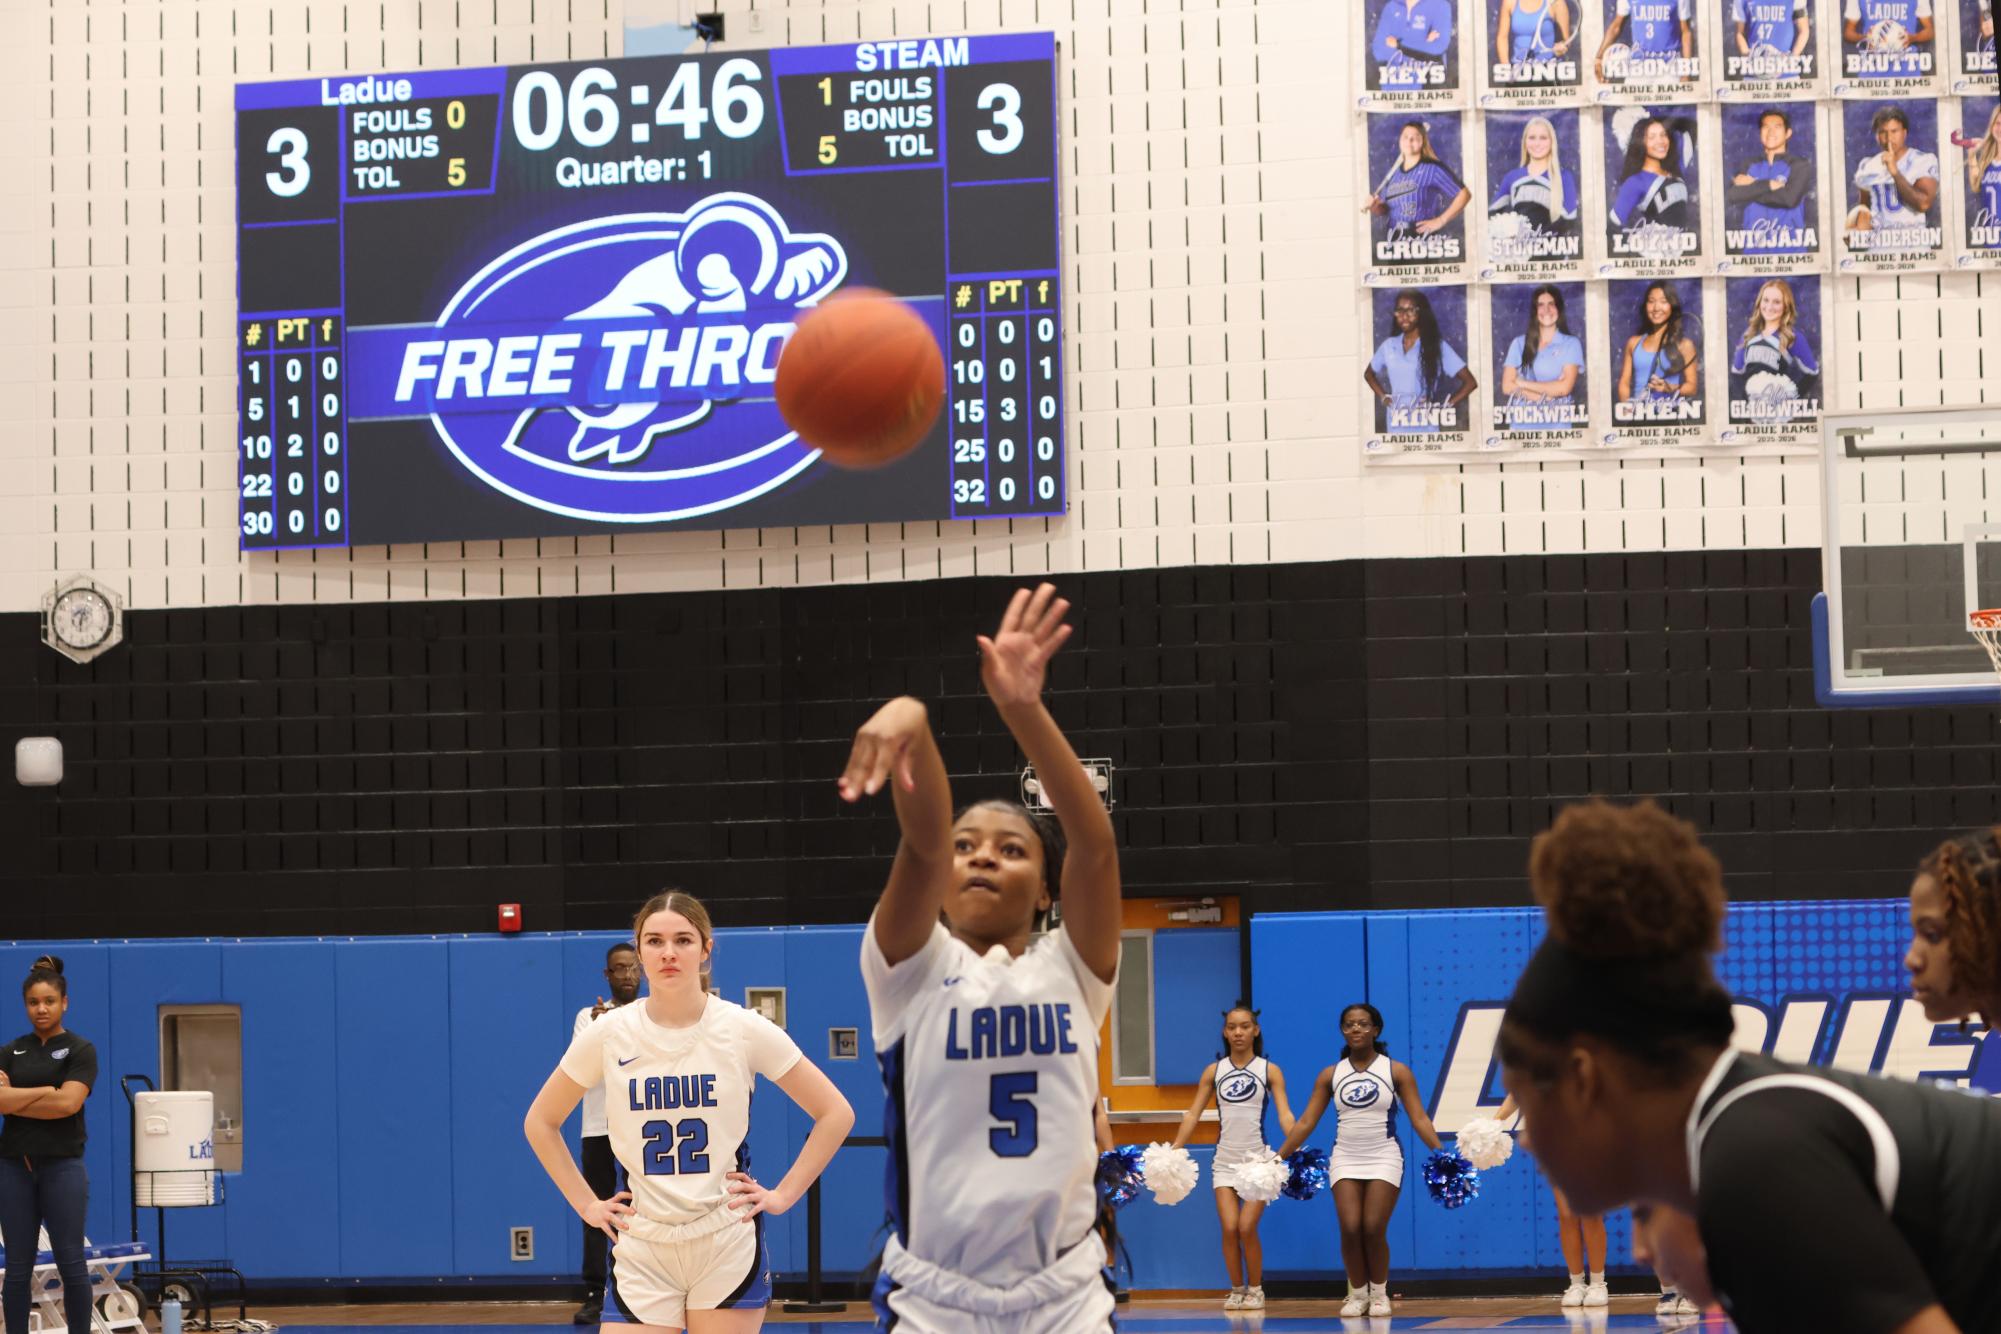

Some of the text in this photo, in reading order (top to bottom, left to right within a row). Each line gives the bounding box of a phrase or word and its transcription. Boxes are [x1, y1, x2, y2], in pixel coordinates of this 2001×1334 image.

[1634, 5, 1671, 21] LADUE
[1867, 4, 1907, 20] LADUE
[1646, 24, 1654, 39] 3
[1757, 24, 1773, 39] 47
[854, 36, 970, 72] STEAM
[1728, 54, 1814, 75] PROSKEY
[1378, 64, 1445, 84] KEYS
[1731, 81, 1812, 91] LADUE RAMS
[1850, 78, 1930, 88] LADUE RAMS
[319, 74, 413, 106] Ladue
[818, 76, 932, 106] 1 FOULS
[1373, 90, 1453, 101] LADUE RAMS
[1496, 88, 1576, 98] LADUE RAMS
[1613, 83, 1694, 94] LADUE RAMS
[353, 100, 466, 134] FOULS 0
[512, 57, 765, 151] 06:46
[843, 104, 933, 132] BONUS
[976, 82, 1024, 155] 3
[265, 127, 311, 197] 3
[353, 134, 440, 162] BONUS
[818, 133, 934, 164] 5 TOL
[353, 157, 466, 189] TOL 5
[555, 150, 712, 188] Quarter: 1
[1377, 239, 1460, 259] CROSS
[1850, 227, 1942, 248] HENDERSON
[1970, 226, 2001, 246] DU
[1380, 265, 1460, 276] LADUE RAMS
[1497, 262, 1578, 272] LADUE RAMS
[1615, 258, 1696, 268] LADUE RAMS
[1732, 255, 1814, 265] LADUE RAMS
[1856, 253, 1936, 262] LADUE RAMS
[955, 279, 1049, 308] # PT f
[245, 318, 332, 346] # PT f
[958, 317, 1054, 348] 0 0 0
[248, 356, 338, 384] 1 0 0
[394, 321, 798, 402] FREE THRO
[953, 356, 1052, 384] 10 0 1
[248, 393, 339, 421] 5 1 0
[954, 395, 1056, 423] 15 3 0
[1392, 408, 1456, 427] KING
[1494, 404, 1589, 424] STOCKWELL
[1615, 400, 1702, 421] CHEN
[1383, 433, 1464, 443] LADUE RAMS
[1501, 430, 1582, 440] LADUE RAMS
[1619, 427, 1700, 437] LADUE RAMS
[1736, 424, 1818, 434] LADUE RAMS
[242, 431, 339, 459] 10 2 0
[954, 436, 1054, 463] 25 0 0
[242, 470, 340, 498] 22 0 0
[953, 475, 1055, 503] 32 0 0
[243, 507, 341, 535] 30 0 0
[946, 1003, 1078, 1060] LADUE
[1428, 993, 1988, 1139] LUE
[628, 1073, 718, 1111] LADUE
[988, 1071, 1038, 1158] 5
[642, 1117, 710, 1176] 22
